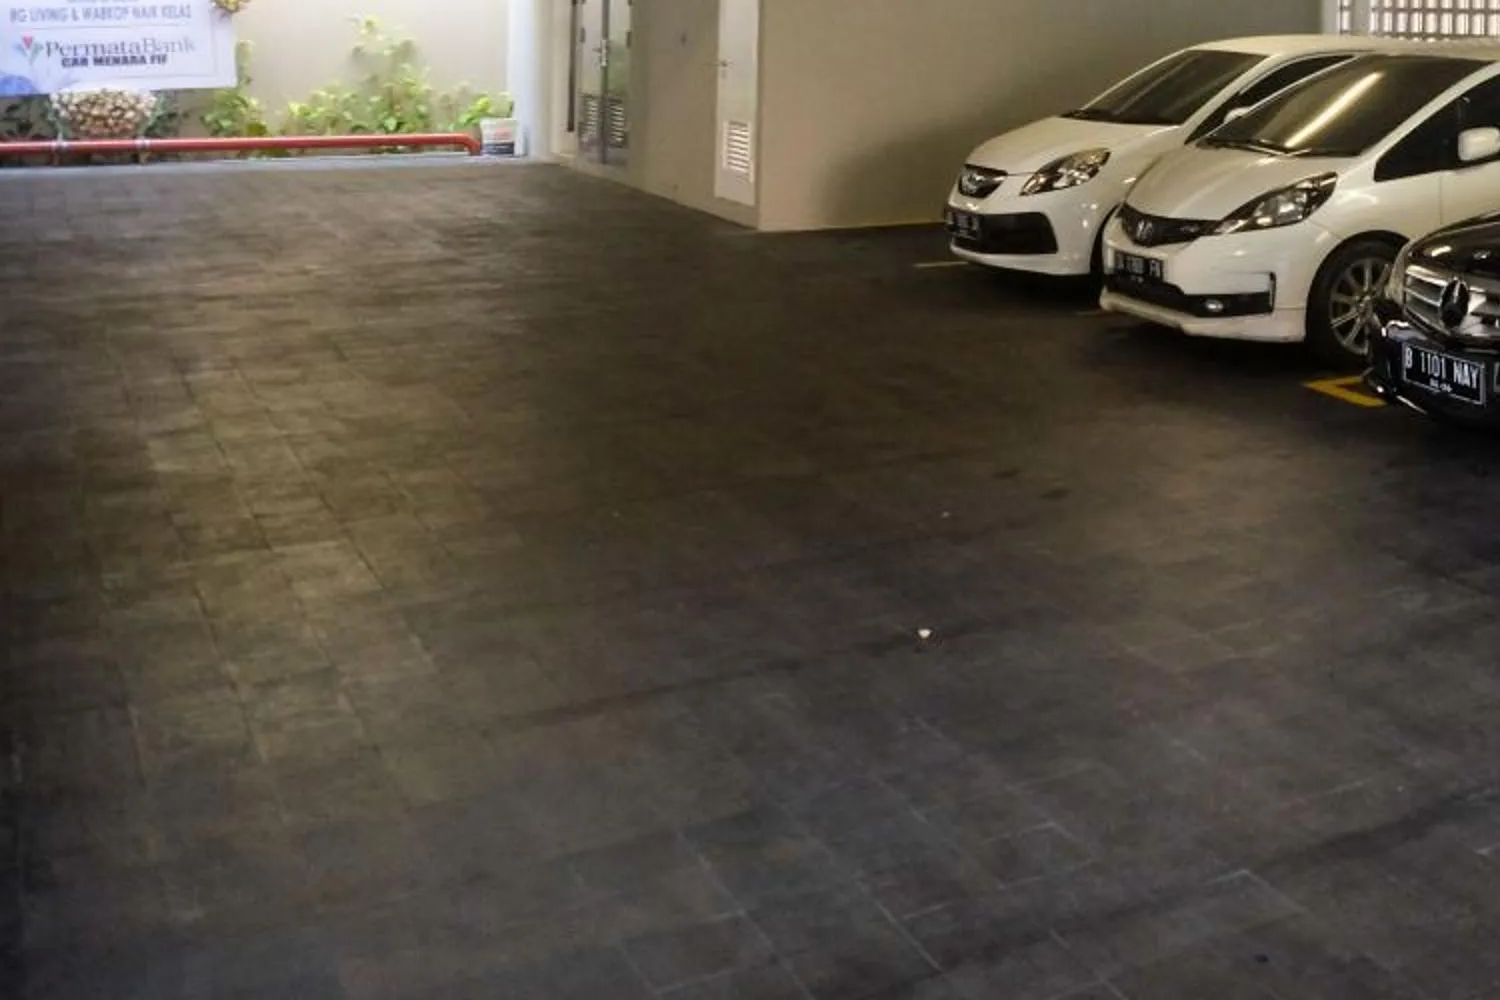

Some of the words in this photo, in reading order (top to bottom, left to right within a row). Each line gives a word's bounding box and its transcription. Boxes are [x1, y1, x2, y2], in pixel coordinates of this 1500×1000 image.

[45, 37, 195, 57] PermataBank
[1405, 347, 1413, 369] B
[1421, 351, 1446, 379] 1101
